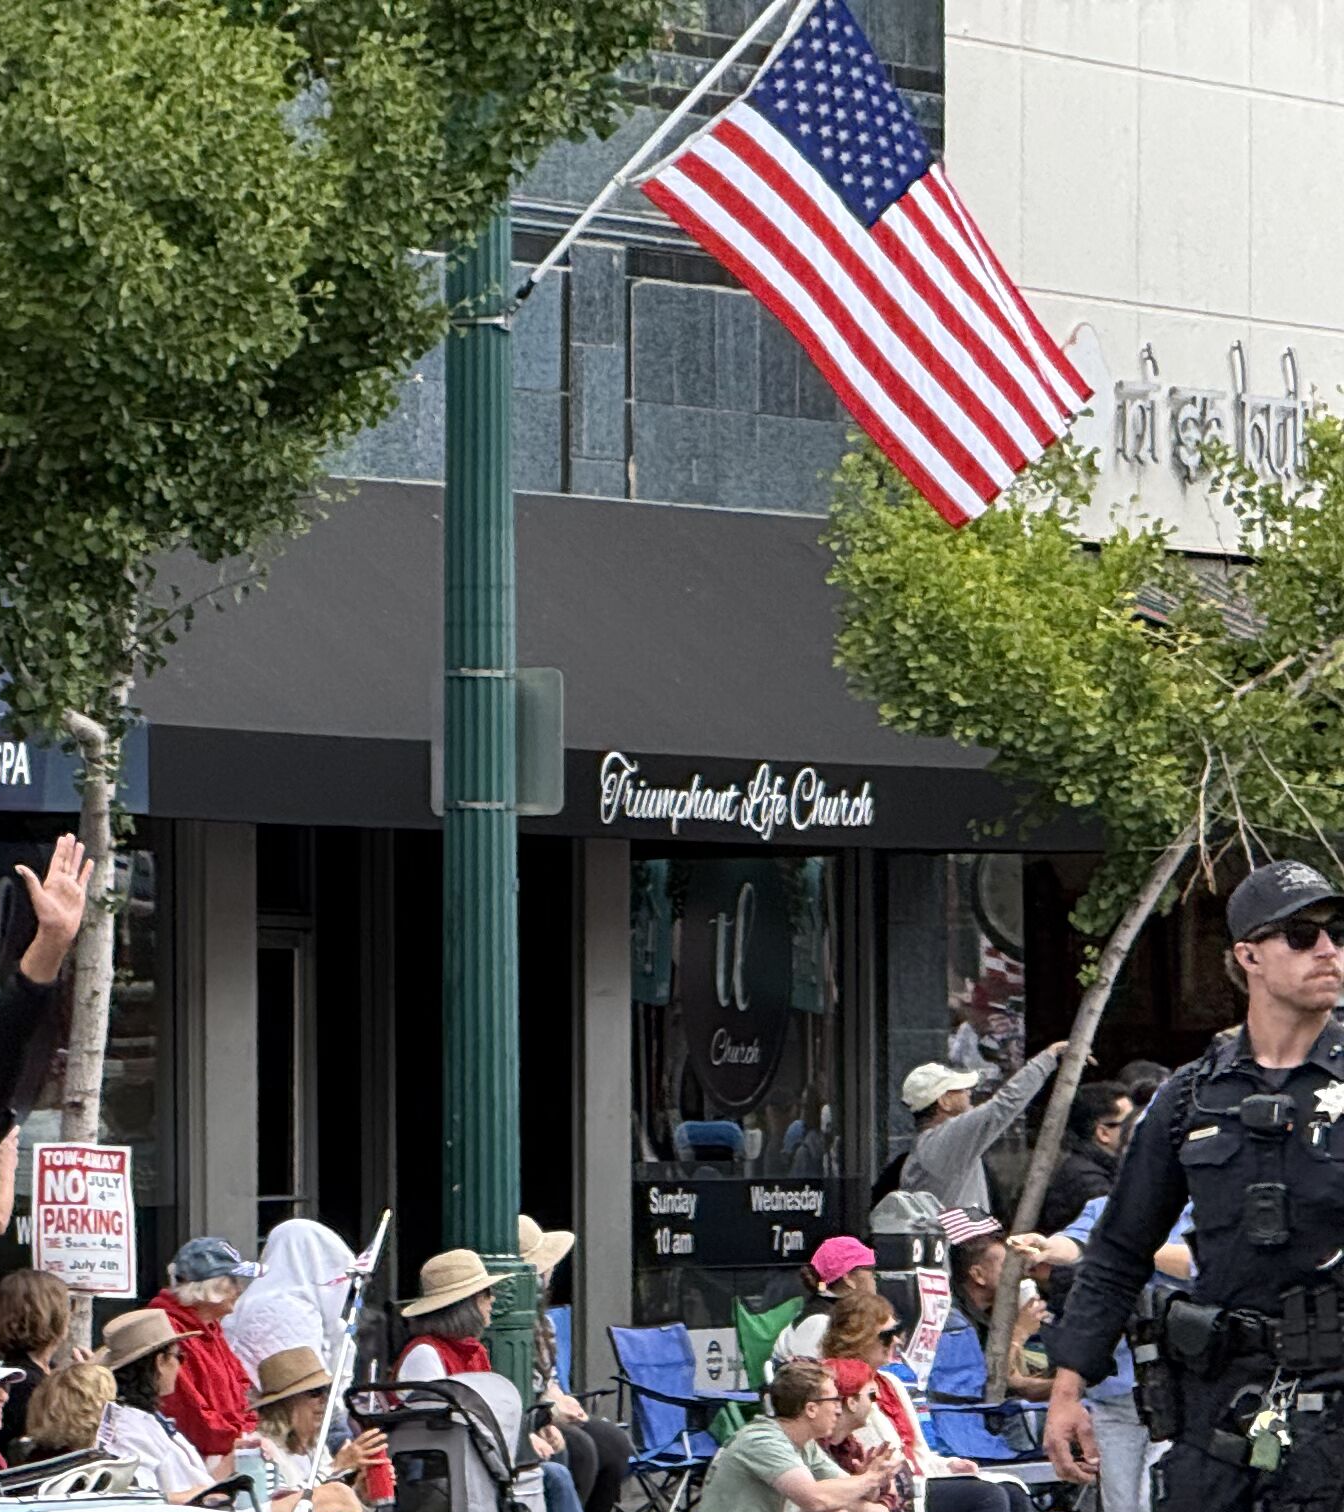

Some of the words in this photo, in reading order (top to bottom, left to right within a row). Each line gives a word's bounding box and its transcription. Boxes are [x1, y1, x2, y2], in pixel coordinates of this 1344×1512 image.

[600, 751, 742, 835] Triumphant
[740, 763, 787, 841] Life
[790, 767, 874, 831] Church
[42, 1150, 121, 1170] TOW-AWAY
[44, 1168, 85, 1203] NO
[88, 1176, 120, 1189] JULY
[649, 1187, 698, 1219] Sunday
[750, 1185, 824, 1217] Wednesday
[44, 1208, 123, 1236] PARKING
[654, 1227, 671, 1254] 10
[672, 1233, 694, 1254] am
[772, 1225, 782, 1251] 7
[783, 1230, 804, 1257] pm
